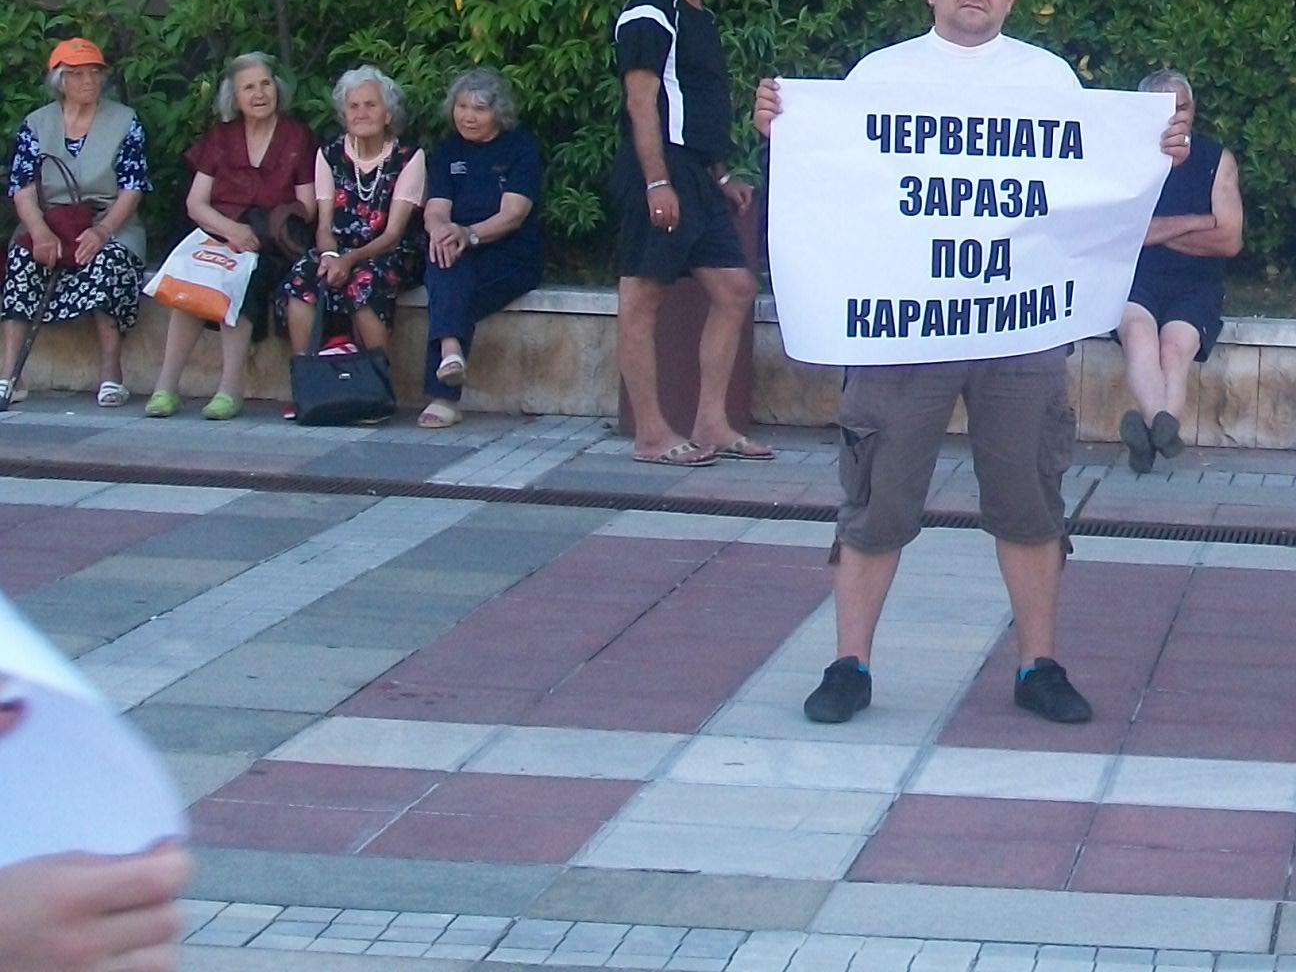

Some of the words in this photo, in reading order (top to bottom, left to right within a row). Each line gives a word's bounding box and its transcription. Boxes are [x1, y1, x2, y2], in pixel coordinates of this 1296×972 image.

[866, 113, 1084, 160] ЧЕРВЕНАТА
[899, 175, 1049, 218] ЗАРАЗА
[931, 238, 1011, 284] ПОД
